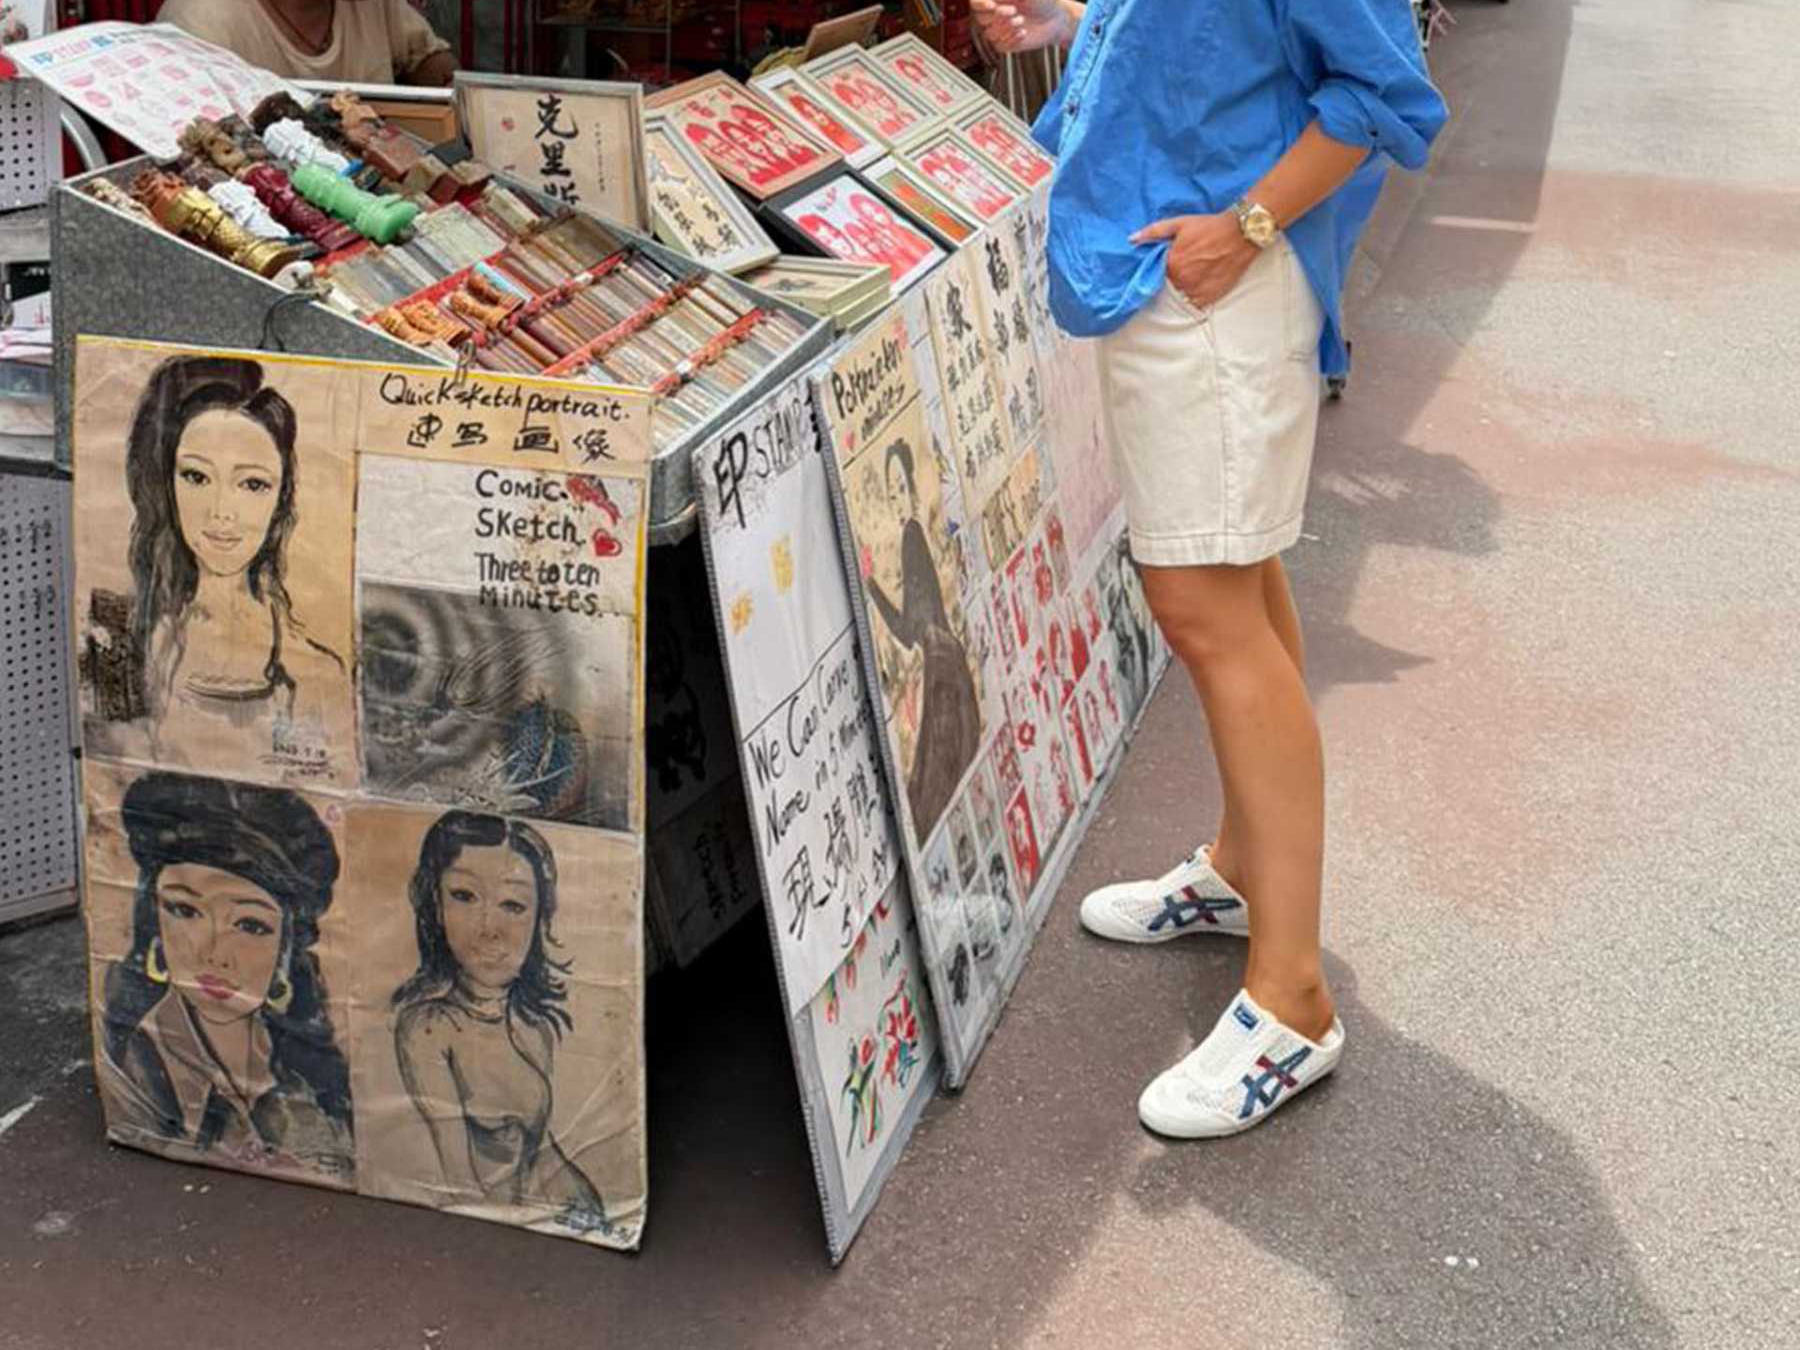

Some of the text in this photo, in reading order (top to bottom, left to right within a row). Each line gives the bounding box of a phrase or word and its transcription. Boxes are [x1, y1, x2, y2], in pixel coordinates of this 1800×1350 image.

[379, 372, 456, 408] Quick
[474, 552, 600, 587] Three to ten
[748, 731, 786, 790] We
[786, 695, 818, 758] Can
[764, 788, 811, 857] Name
